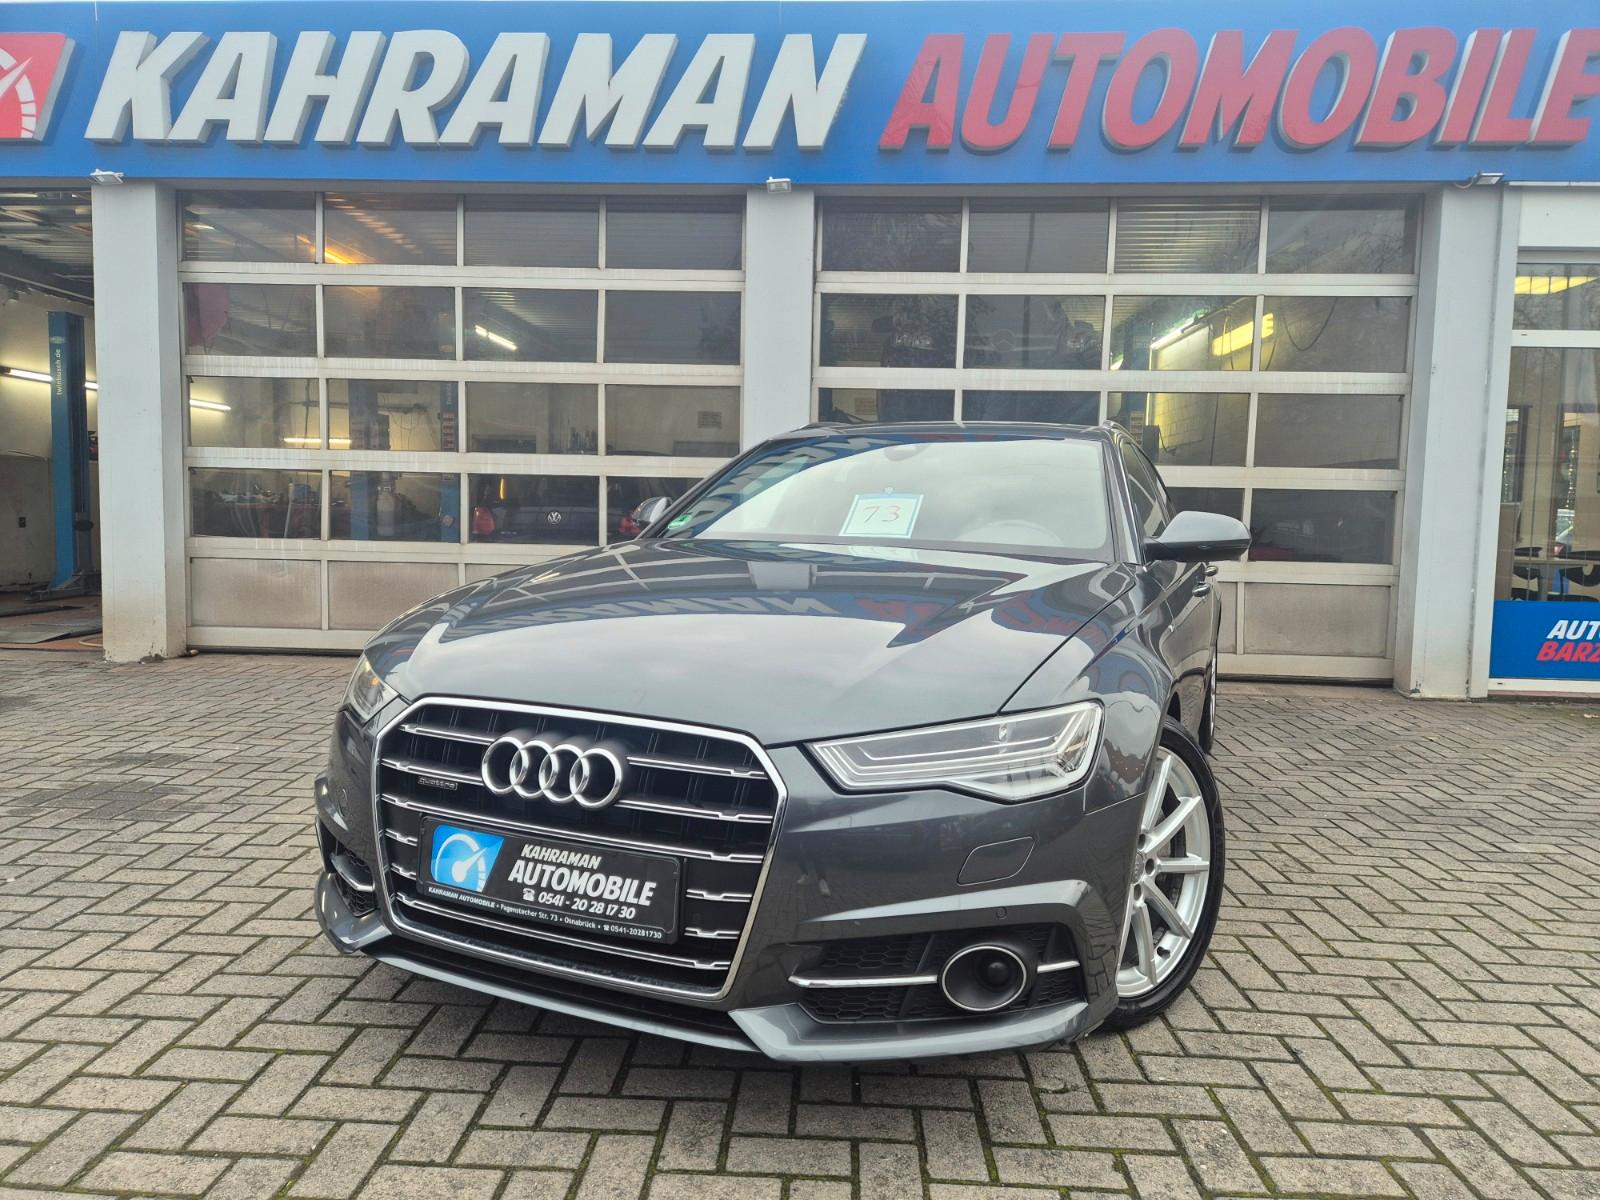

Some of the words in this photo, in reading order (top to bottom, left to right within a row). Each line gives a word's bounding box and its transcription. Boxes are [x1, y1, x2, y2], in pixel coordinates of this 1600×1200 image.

[84, 30, 868, 150] KAHRAMAN
[879, 26, 1600, 152] AUTOMOBILE
[863, 504, 902, 524] 73
[1546, 619, 1600, 640] AUT
[520, 844, 602, 870] KAHRAMAN
[507, 859, 657, 907] AUTOMOBILE
[428, 886, 459, 899] KAHRAMAN
[458, 895, 496, 909] AUTOMOBILE
[538, 911, 549, 921] Str.
[550, 913, 558, 922] 73
[564, 916, 596, 929] Osnabrück
[610, 924, 662, 940] 0541-20281730
[537, 891, 565, 907] 0541
[571, 897, 588, 911] 20
[588, 900, 605, 915] 28
[605, 903, 619, 917] 17
[618, 906, 636, 920] 30
